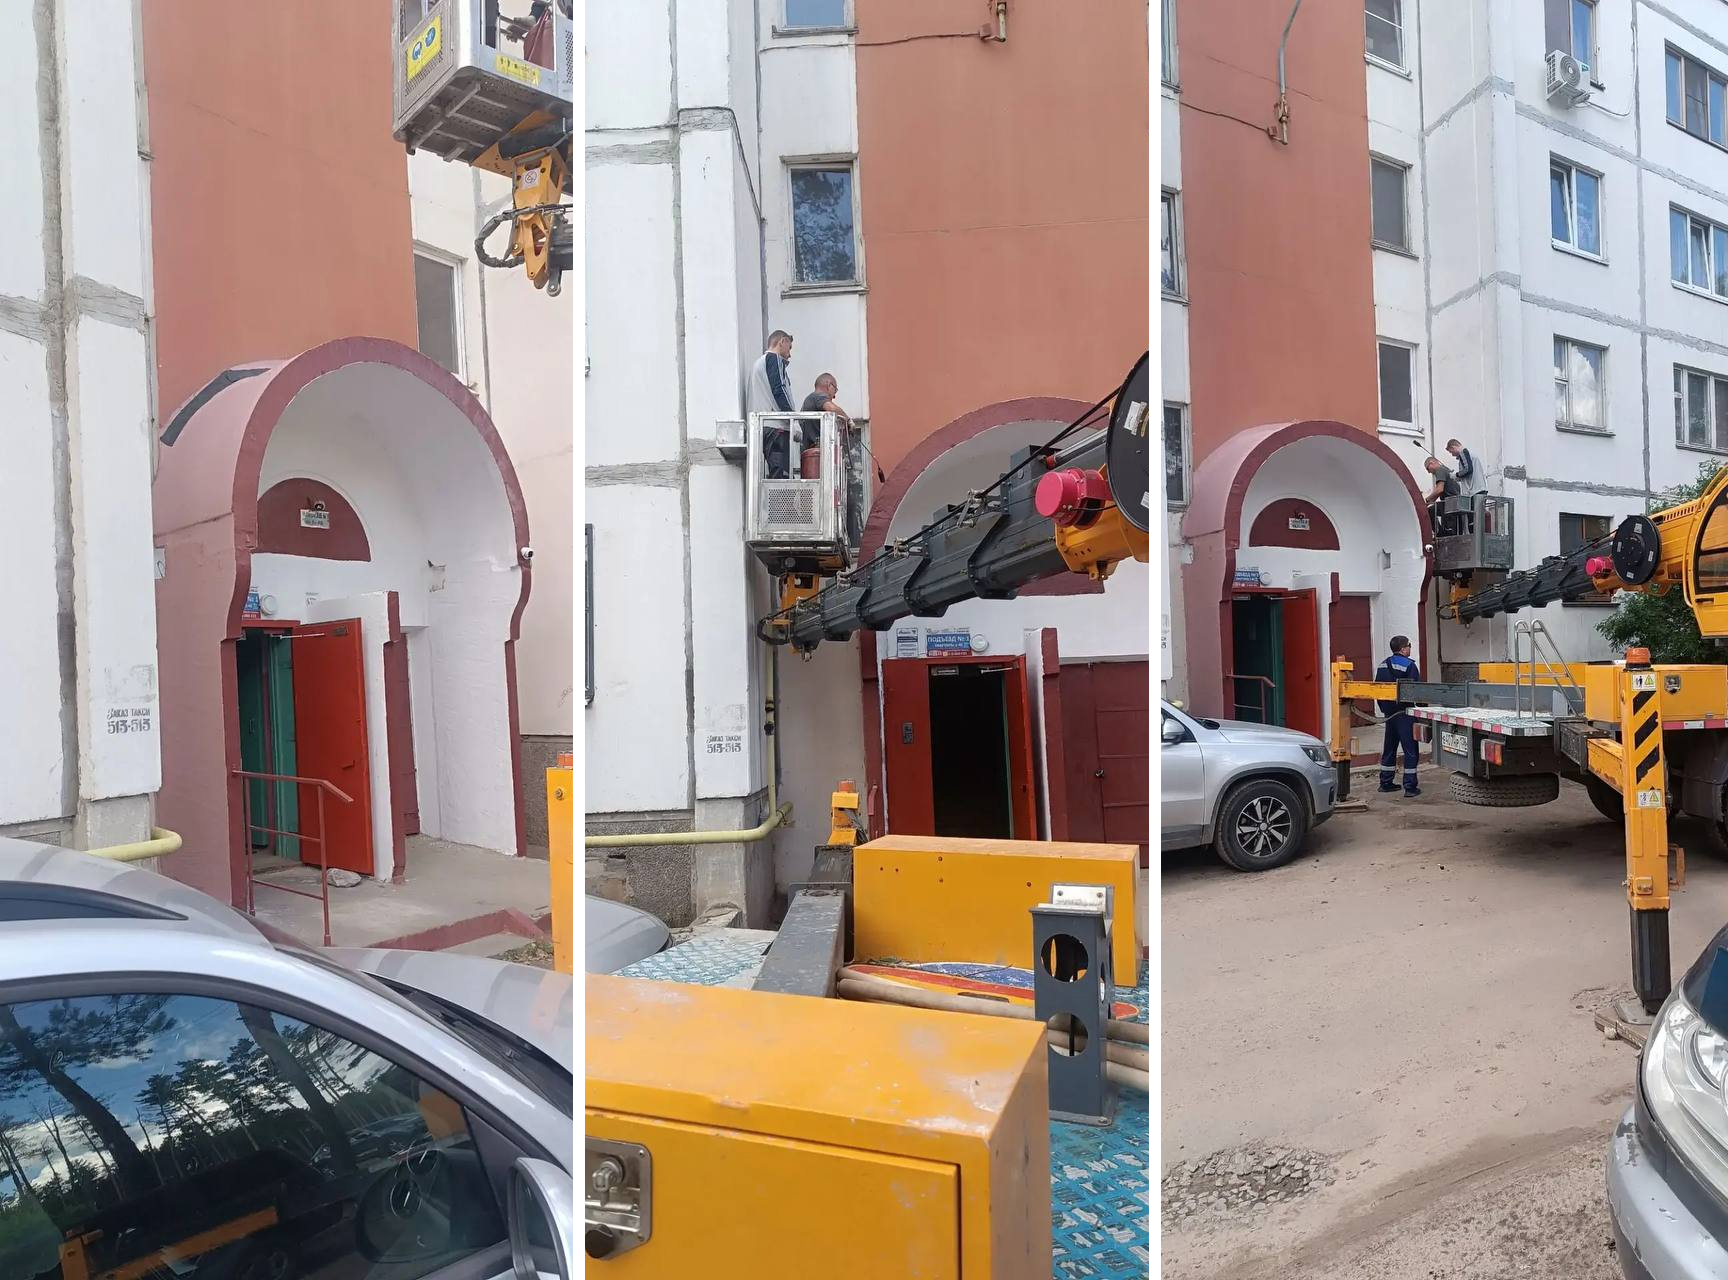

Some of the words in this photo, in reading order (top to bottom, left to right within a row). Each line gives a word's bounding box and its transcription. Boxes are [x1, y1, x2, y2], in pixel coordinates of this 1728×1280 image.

[927, 635, 957, 643] ПОДЪЕЗД
[107, 718, 151, 734] 513-513
[706, 742, 742, 754] 513-513
